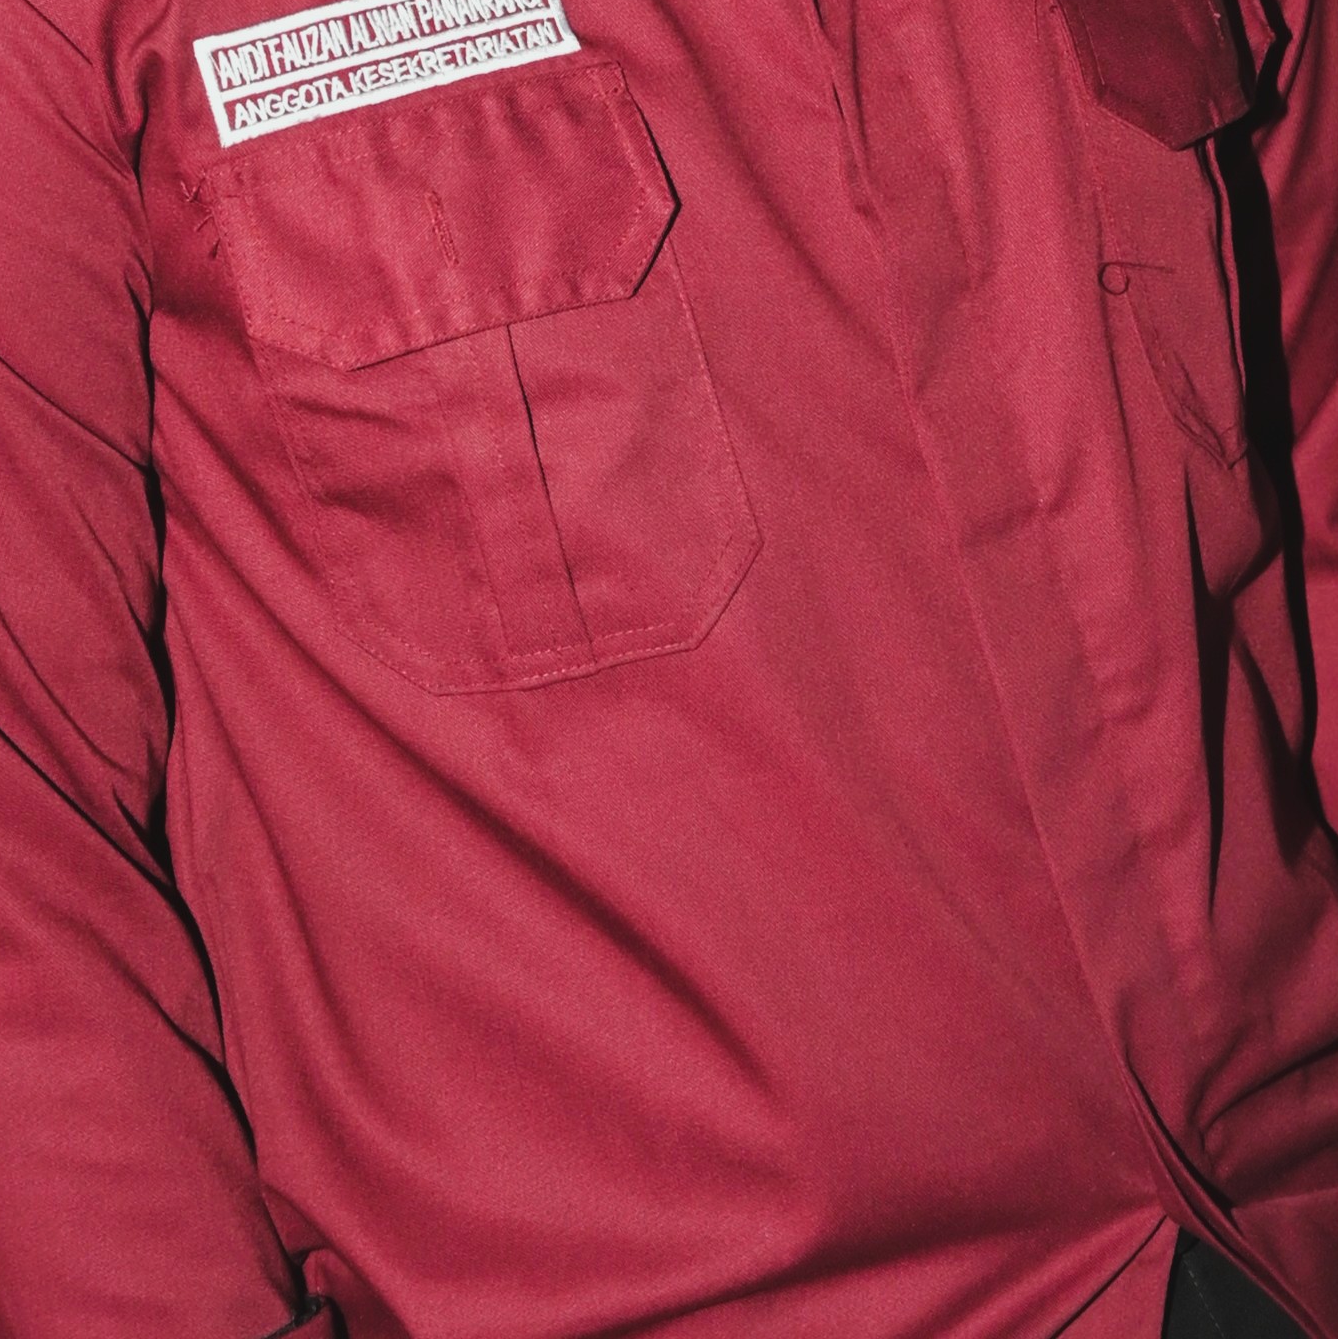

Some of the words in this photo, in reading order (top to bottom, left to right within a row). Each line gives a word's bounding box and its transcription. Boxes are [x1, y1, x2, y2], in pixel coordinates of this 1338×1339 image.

[217, 42, 267, 90] ANDI
[262, 18, 350, 76] FAUZAN
[350, 1, 422, 54] ALWAN
[234, 76, 347, 129] ANGGOTA
[349, 19, 555, 95] KESEKRETARIATAN
